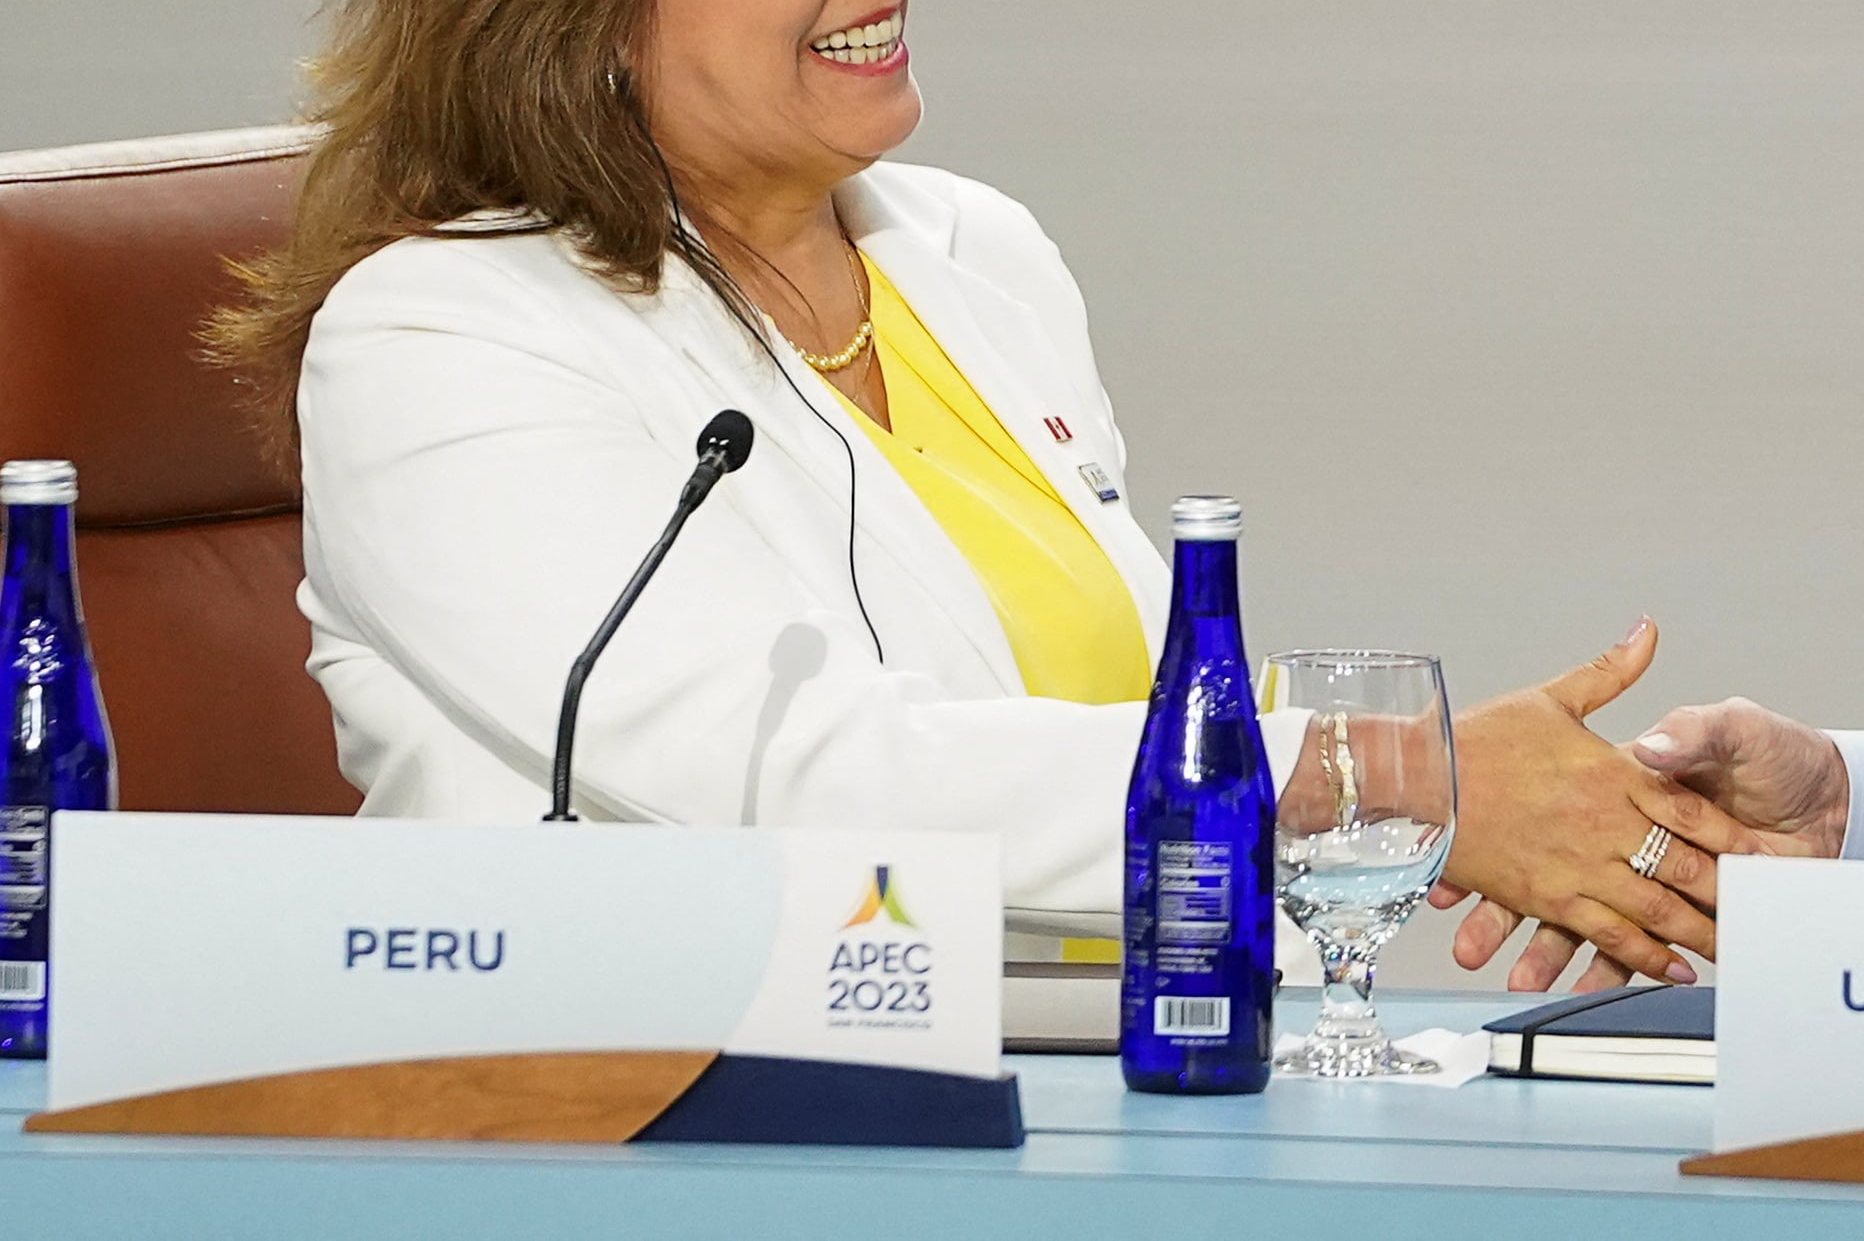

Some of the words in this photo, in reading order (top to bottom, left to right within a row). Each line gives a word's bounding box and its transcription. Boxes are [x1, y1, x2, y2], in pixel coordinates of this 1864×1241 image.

[345, 928, 506, 971] PERU
[828, 942, 931, 975] APEC
[828, 980, 931, 1012] 2023
